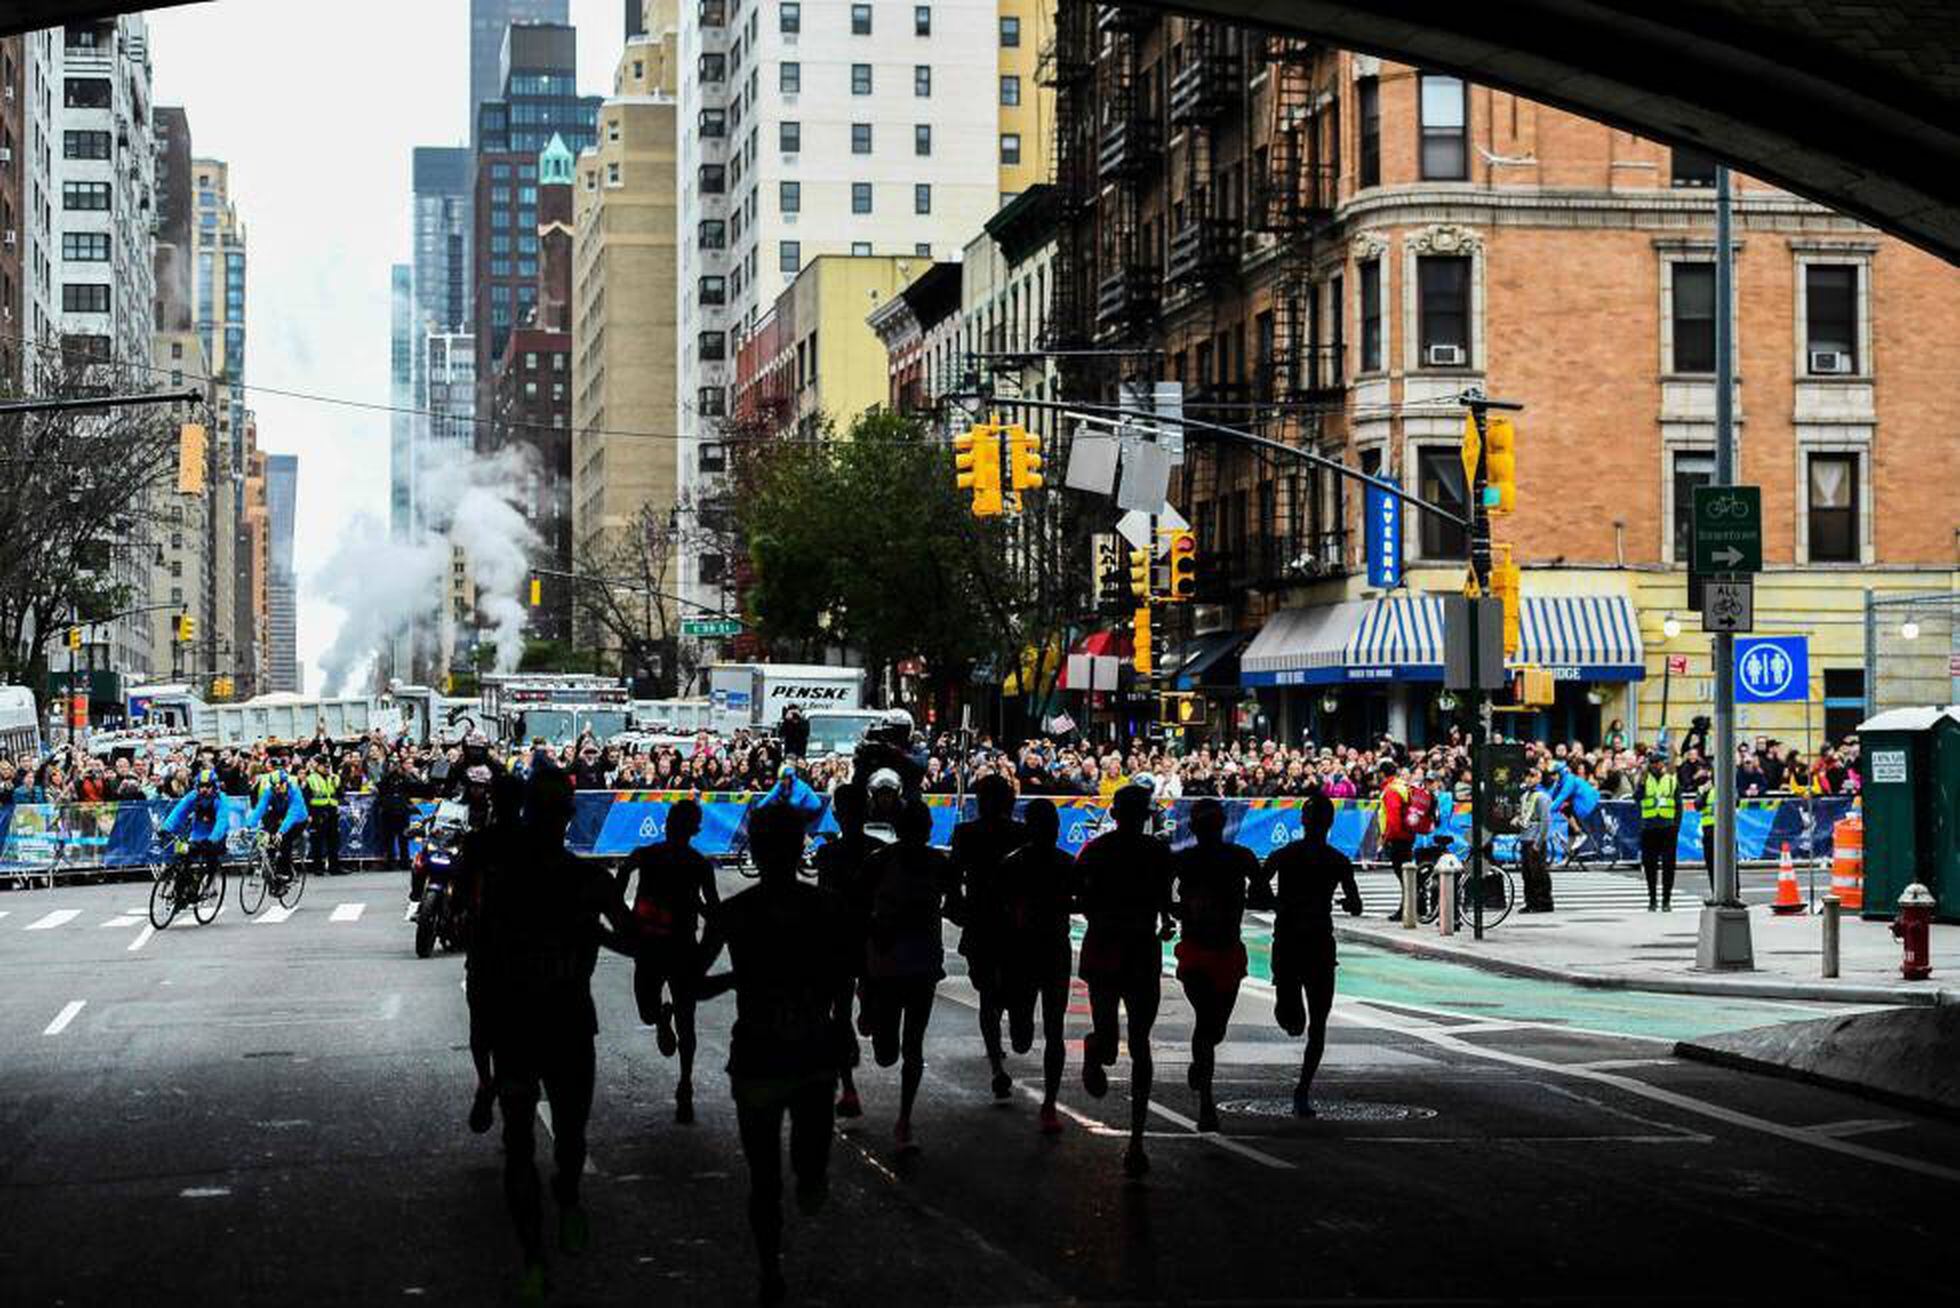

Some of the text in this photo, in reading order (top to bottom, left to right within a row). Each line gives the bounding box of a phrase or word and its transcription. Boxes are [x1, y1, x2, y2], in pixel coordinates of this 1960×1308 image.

[1383, 482, 1394, 583] AVERNA
[1717, 585, 1741, 597] ALL
[771, 685, 851, 700] PENSKE
